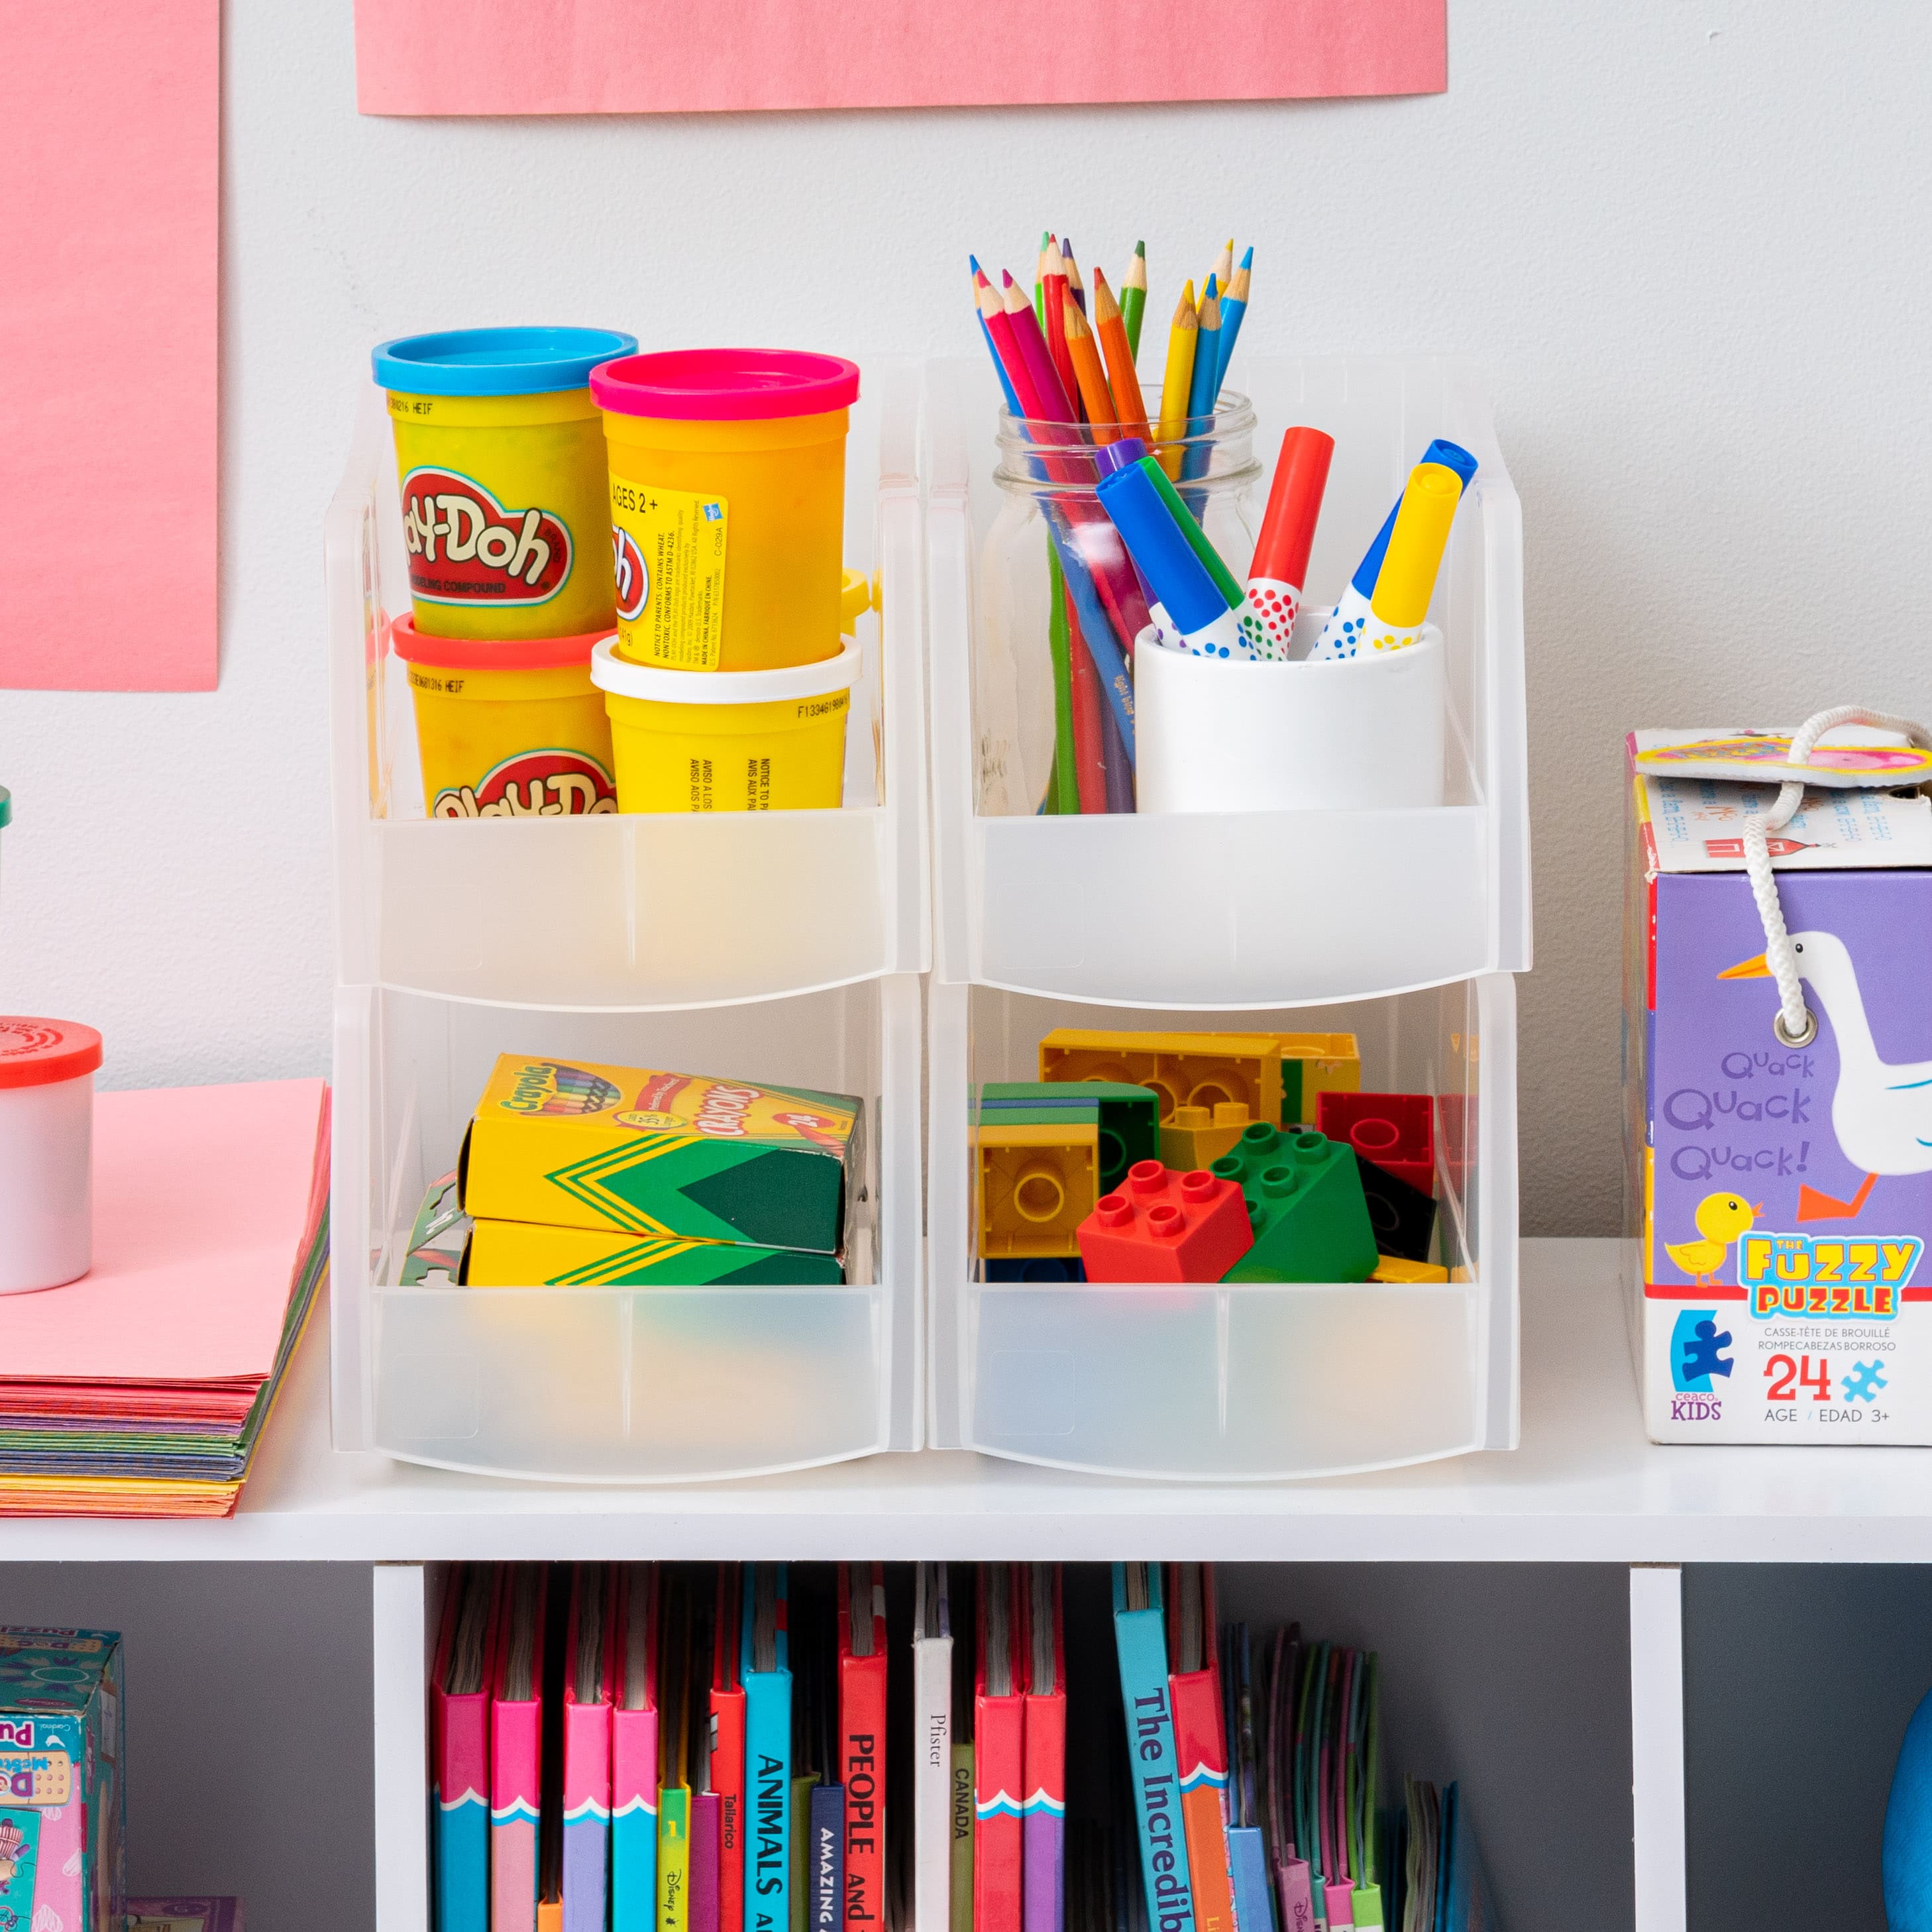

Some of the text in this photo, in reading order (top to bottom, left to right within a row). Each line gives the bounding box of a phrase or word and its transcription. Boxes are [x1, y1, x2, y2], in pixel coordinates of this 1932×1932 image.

[412, 402, 433, 415] HEIF
[612, 484, 636, 510] AGES
[403, 494, 550, 586] ay-Doh
[714, 527, 722, 556] C-029A
[445, 680, 464, 693] HEIF
[690, 759, 700, 783] AVISO
[702, 759, 712, 784] AVISO
[747, 759, 757, 777] AVIS
[760, 758, 771, 788] NOTICE
[690, 784, 700, 802] AOS
[747, 779, 757, 796] AUX
[759, 790, 769, 800] TO
[702, 793, 712, 810] LOS
[500, 1064, 553, 1111] Crayola
[696, 1085, 760, 1136] CRAYONS
[786, 1114, 820, 1128] 24
[1776, 1239, 1803, 1251] THE
[1756, 1286, 1892, 1314] PUZZLE
[1764, 1325, 1890, 1338] CASSE-TÊTE DE BROUILLÉ
[1758, 1341, 1896, 1351] ROMPECABEZAS BORROSO
[1762, 1354, 1831, 1401] 24
[1670, 1401, 1722, 1421] KIDS
[1764, 1409, 1798, 1422] AGE
[1819, 1409, 1862, 1422] EDAD
[1872, 1409, 1890, 1422] 3+
[40, 1724, 71, 1733] Cardinal
[1134, 1687, 1171, 1762] The
[930, 1713, 947, 1768] Pfister
[848, 1734, 876, 1854] PEOPLE
[954, 1767, 969, 1841] CANADA
[667, 1821, 676, 1837] 1
[724, 1794, 735, 1850] Tallarico
[756, 1754, 784, 1896] ANIMALS
[819, 1827, 835, 1923] AMAZING
